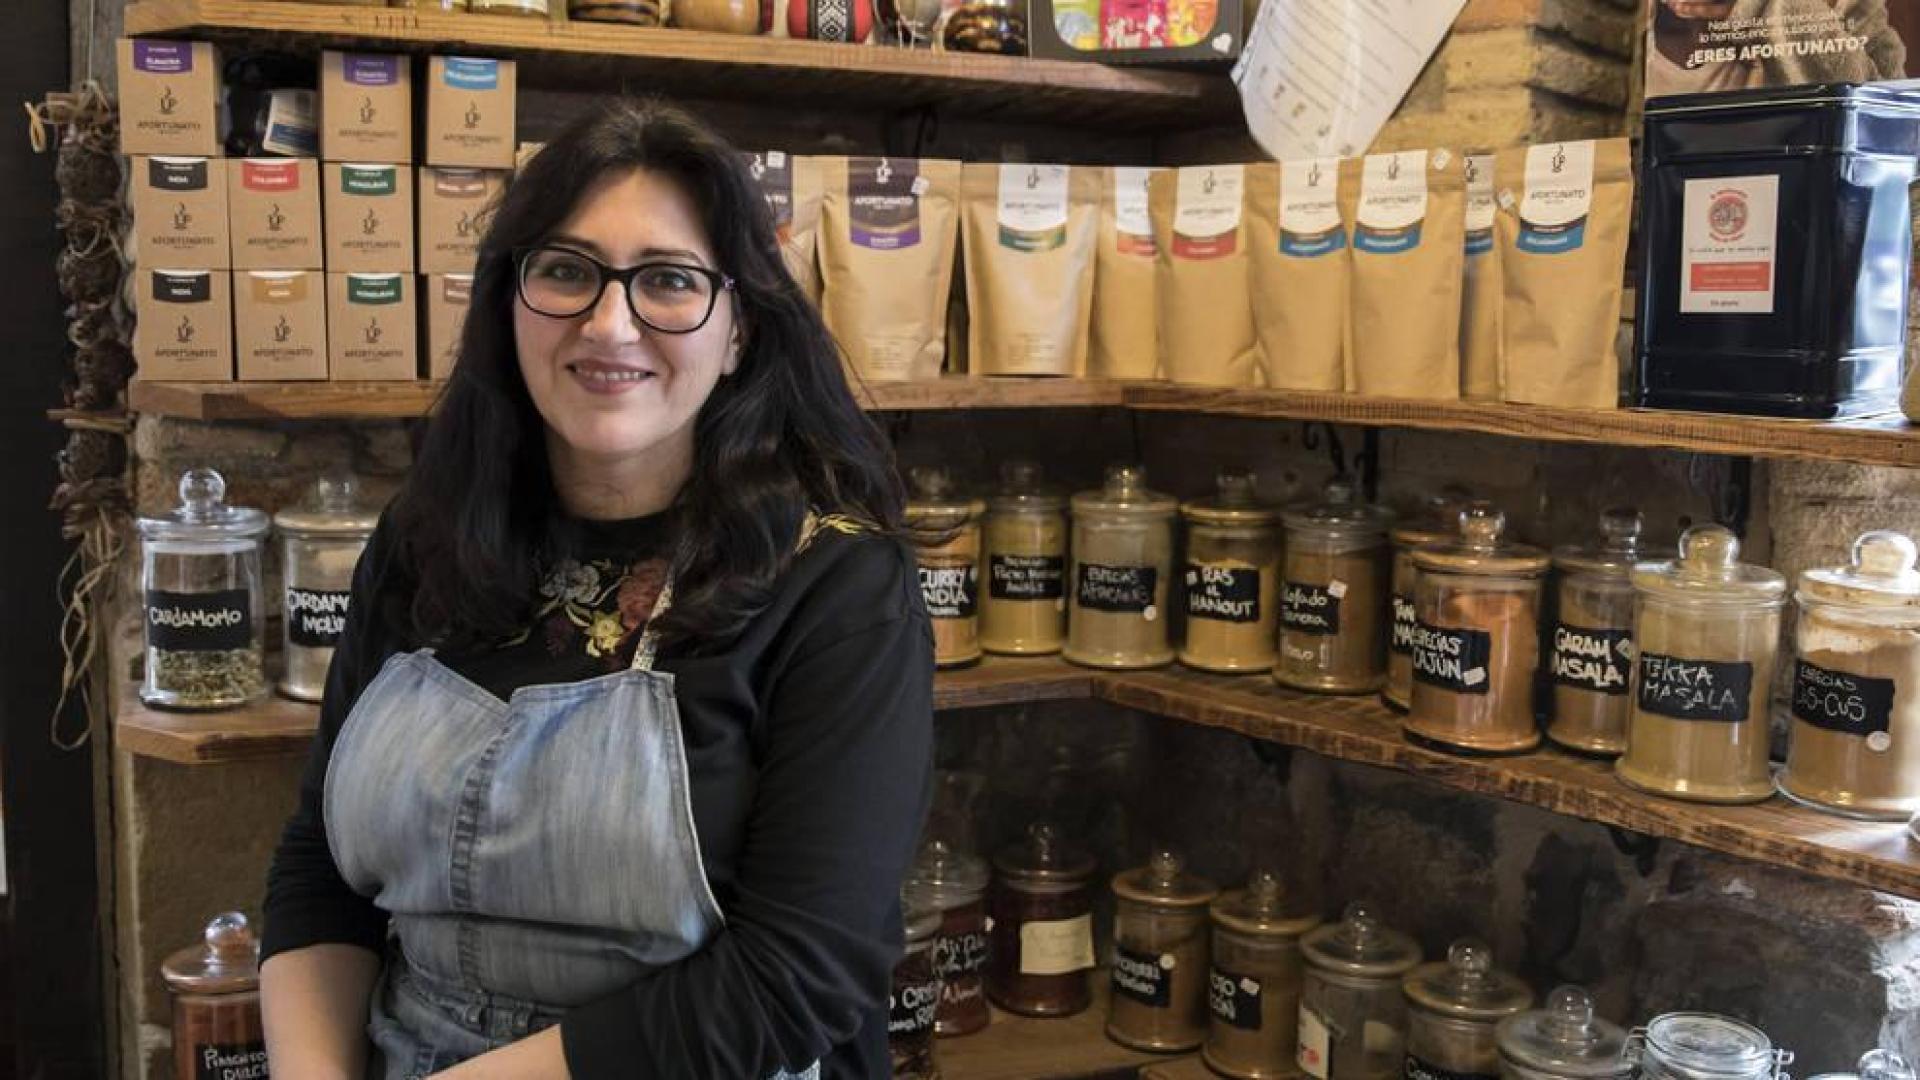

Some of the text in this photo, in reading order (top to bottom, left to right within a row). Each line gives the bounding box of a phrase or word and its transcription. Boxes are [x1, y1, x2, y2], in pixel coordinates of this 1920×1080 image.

[1686, 36, 1869, 69] ¿ERES AFORTUNATO?
[854, 196, 914, 206] AFORTUNATO
[1530, 189, 1586, 200] AFORTUNATO
[1643, 679, 1739, 711] MASALA
